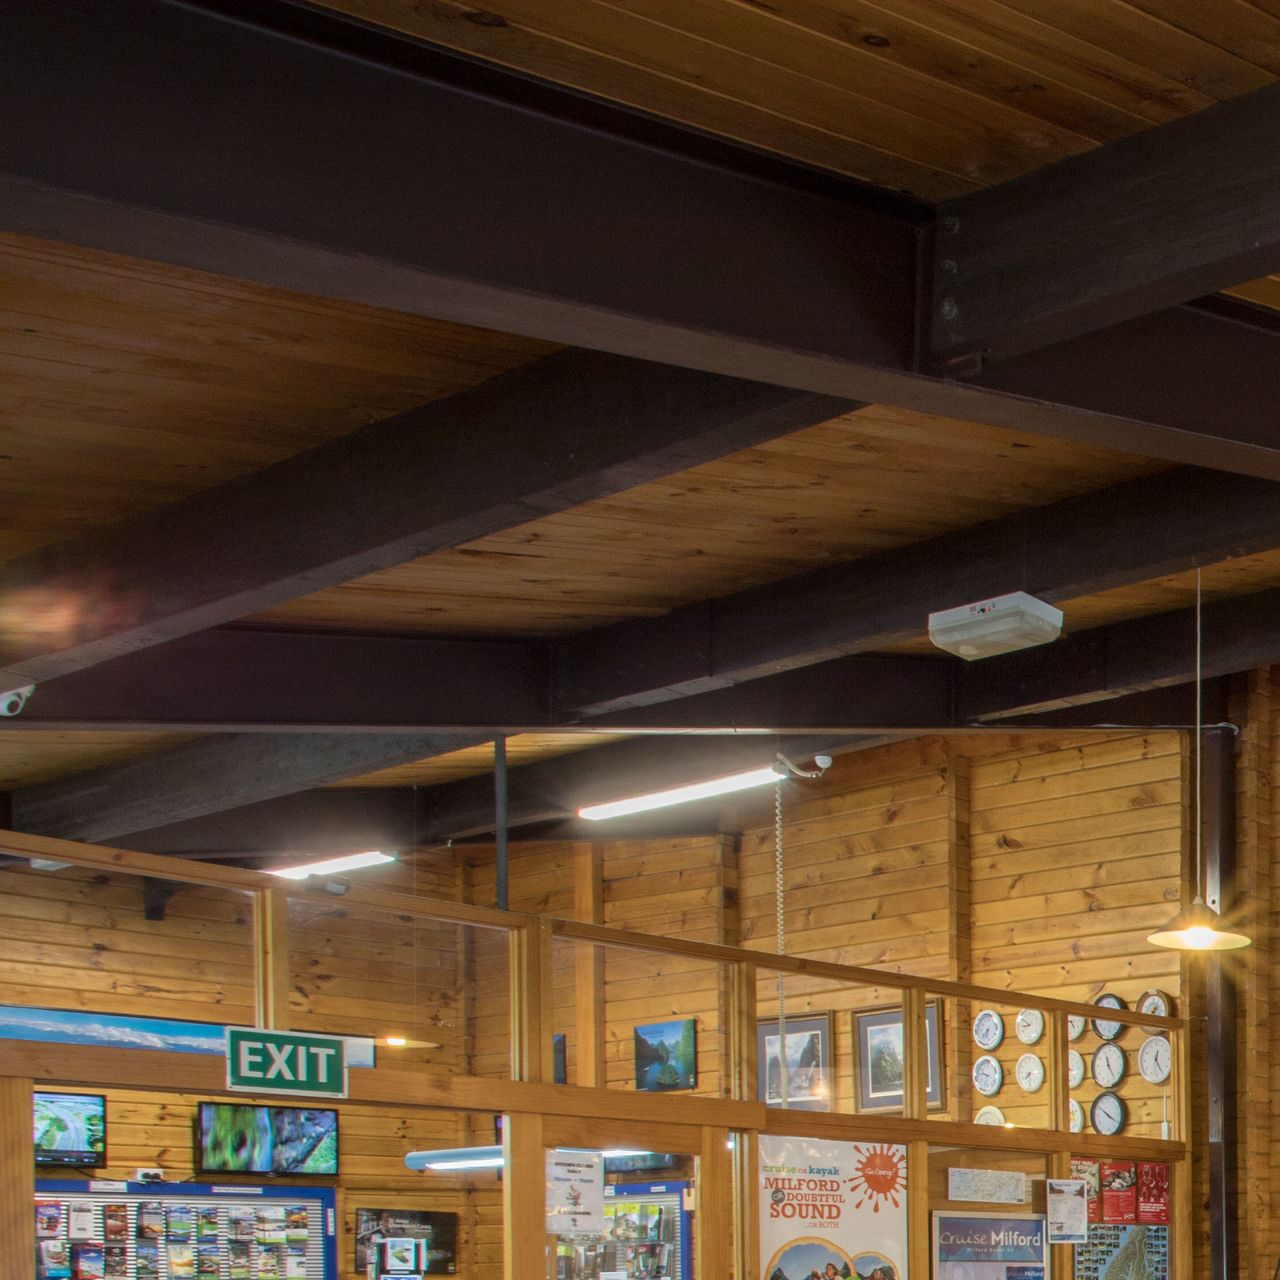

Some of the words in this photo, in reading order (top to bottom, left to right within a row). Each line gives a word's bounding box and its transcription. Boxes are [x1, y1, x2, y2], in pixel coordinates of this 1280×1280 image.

[239, 1041, 336, 1083] EXIT
[808, 1165, 840, 1177] kayak
[764, 1177, 840, 1192] MILFORD
[787, 1192, 846, 1203] DOUBTFUL
[770, 1202, 841, 1220] SOUND
[940, 1230, 988, 1246] Cruise
[990, 1230, 1041, 1247] Milford
